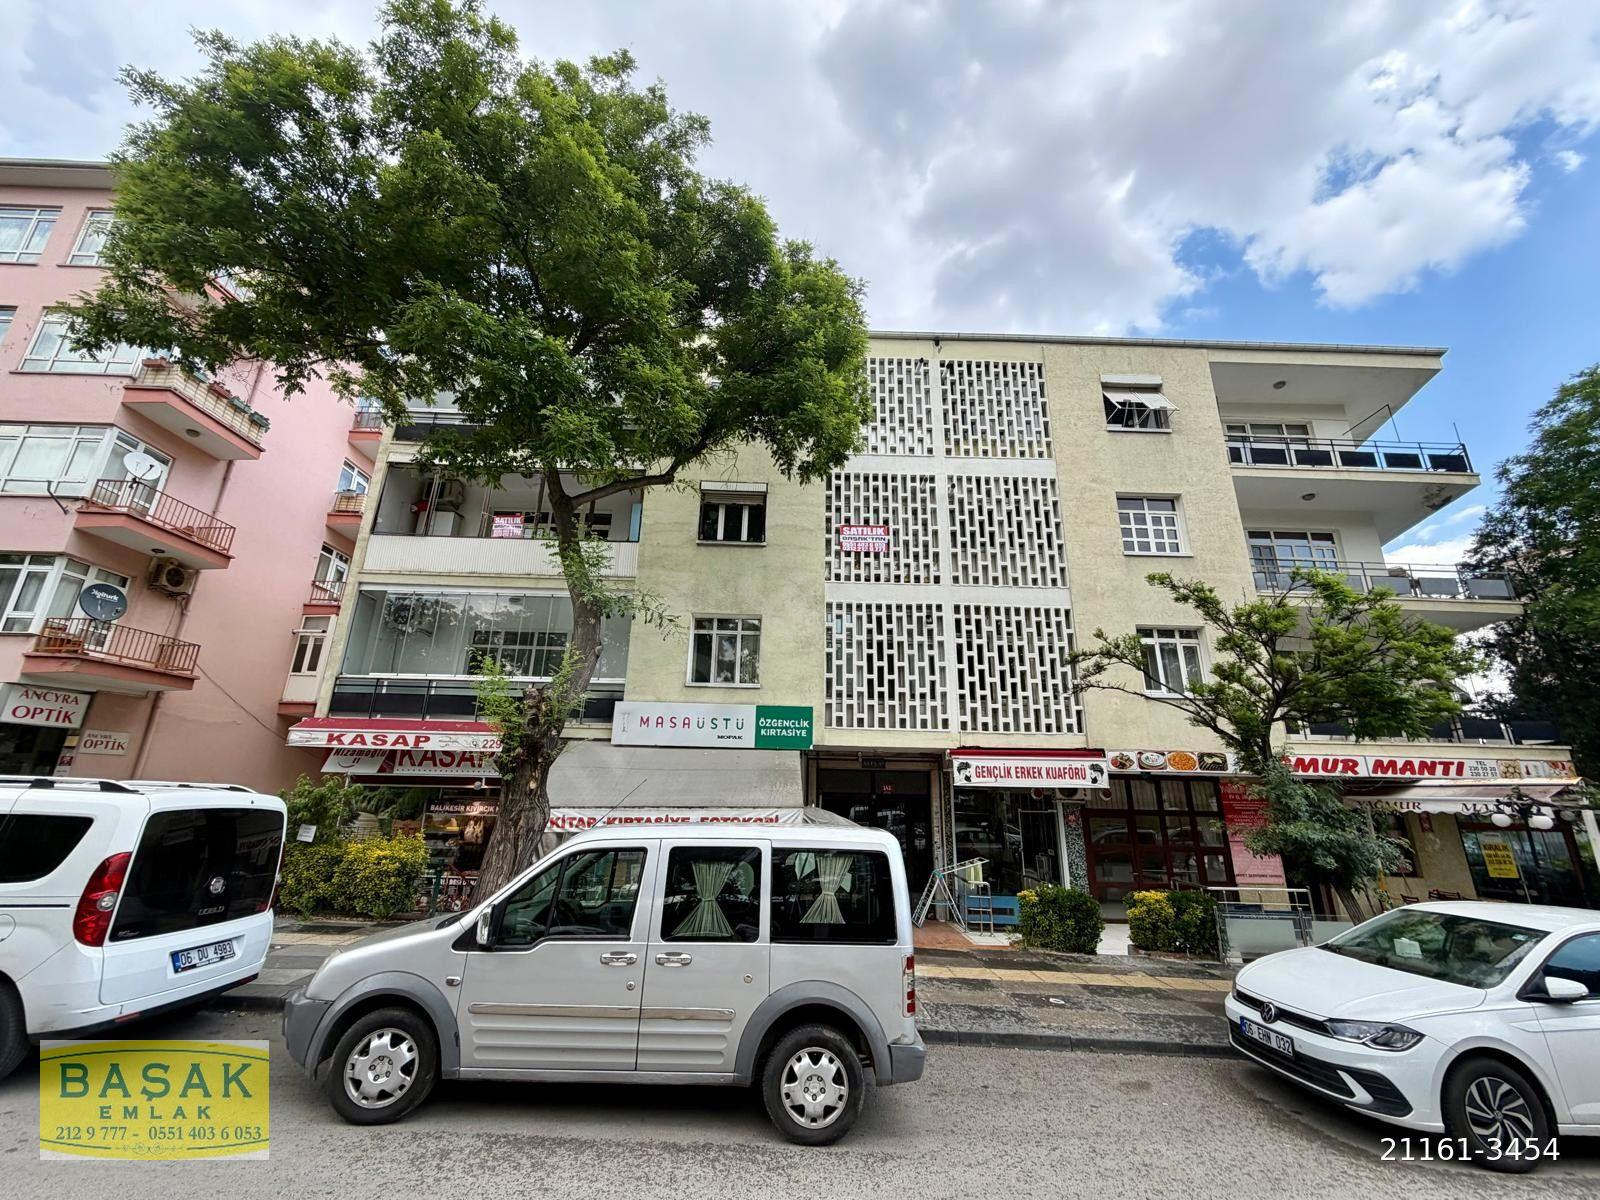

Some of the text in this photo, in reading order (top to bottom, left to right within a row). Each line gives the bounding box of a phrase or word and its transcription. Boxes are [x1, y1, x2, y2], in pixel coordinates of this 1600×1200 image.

[495, 516, 522, 524] SATILIK
[842, 526, 885, 535] SATILIK
[20, 688, 80, 706] ANCYRA
[12, 705, 76, 725] OPTİK
[639, 715, 744, 730] MASAÜSTÜ
[758, 717, 810, 729] ÖZGENÇLİK
[760, 727, 808, 738] KIRTASİYE
[83, 738, 127, 751] OPTİK
[327, 733, 502, 749] KASAP 229
[398, 750, 497, 768] KASAP
[1281, 756, 1465, 776] MUR MANTI
[974, 763, 1087, 780] GENÇLİK ERKEK KUAFÖRÜ
[550, 815, 597, 829] KİTAP
[181, 953, 193, 966] 06
[197, 948, 209, 961] DU
[1276, 1035, 1292, 1054] 032
